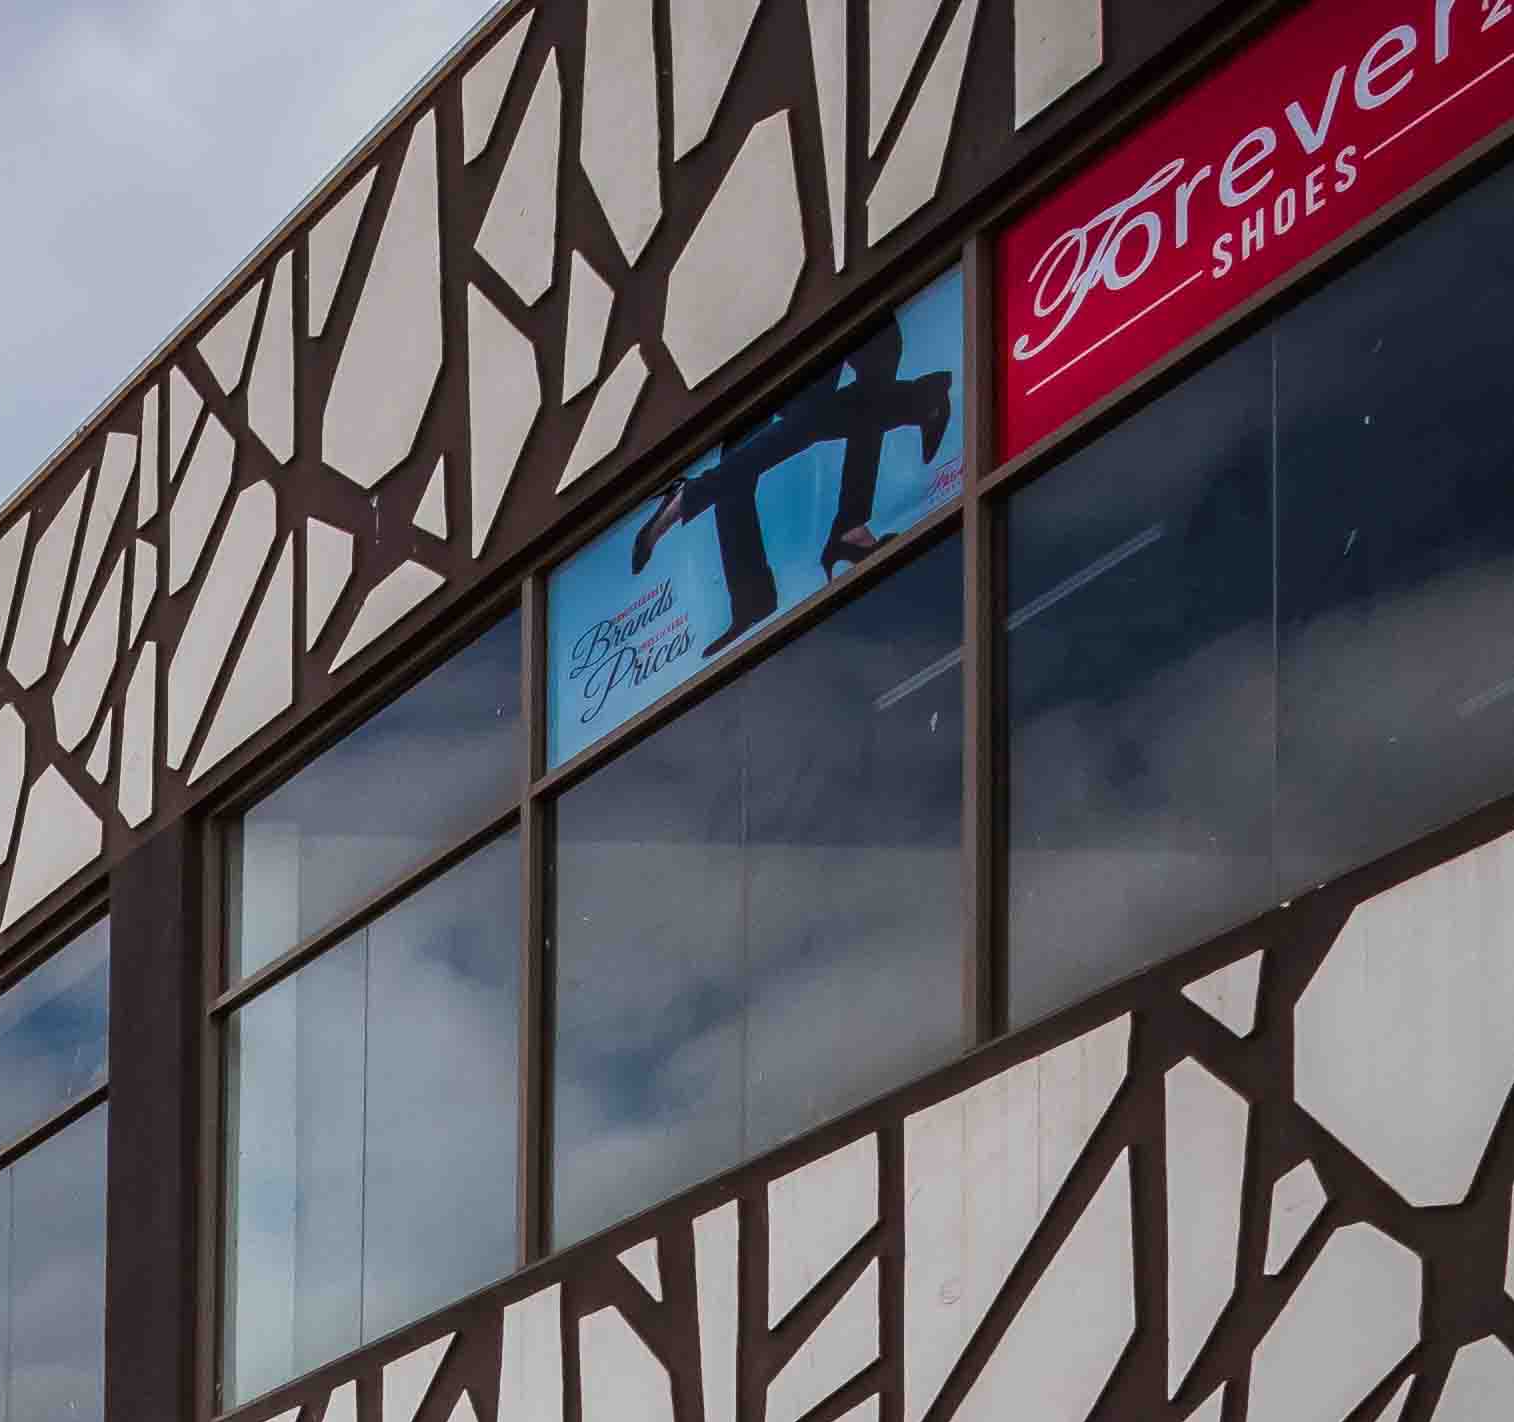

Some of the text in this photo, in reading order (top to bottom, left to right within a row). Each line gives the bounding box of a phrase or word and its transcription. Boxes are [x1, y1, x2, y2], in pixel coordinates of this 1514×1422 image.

[1212, 145, 1358, 279] SHOES
[569, 576, 673, 680] Brands
[580, 627, 695, 724] Prices
